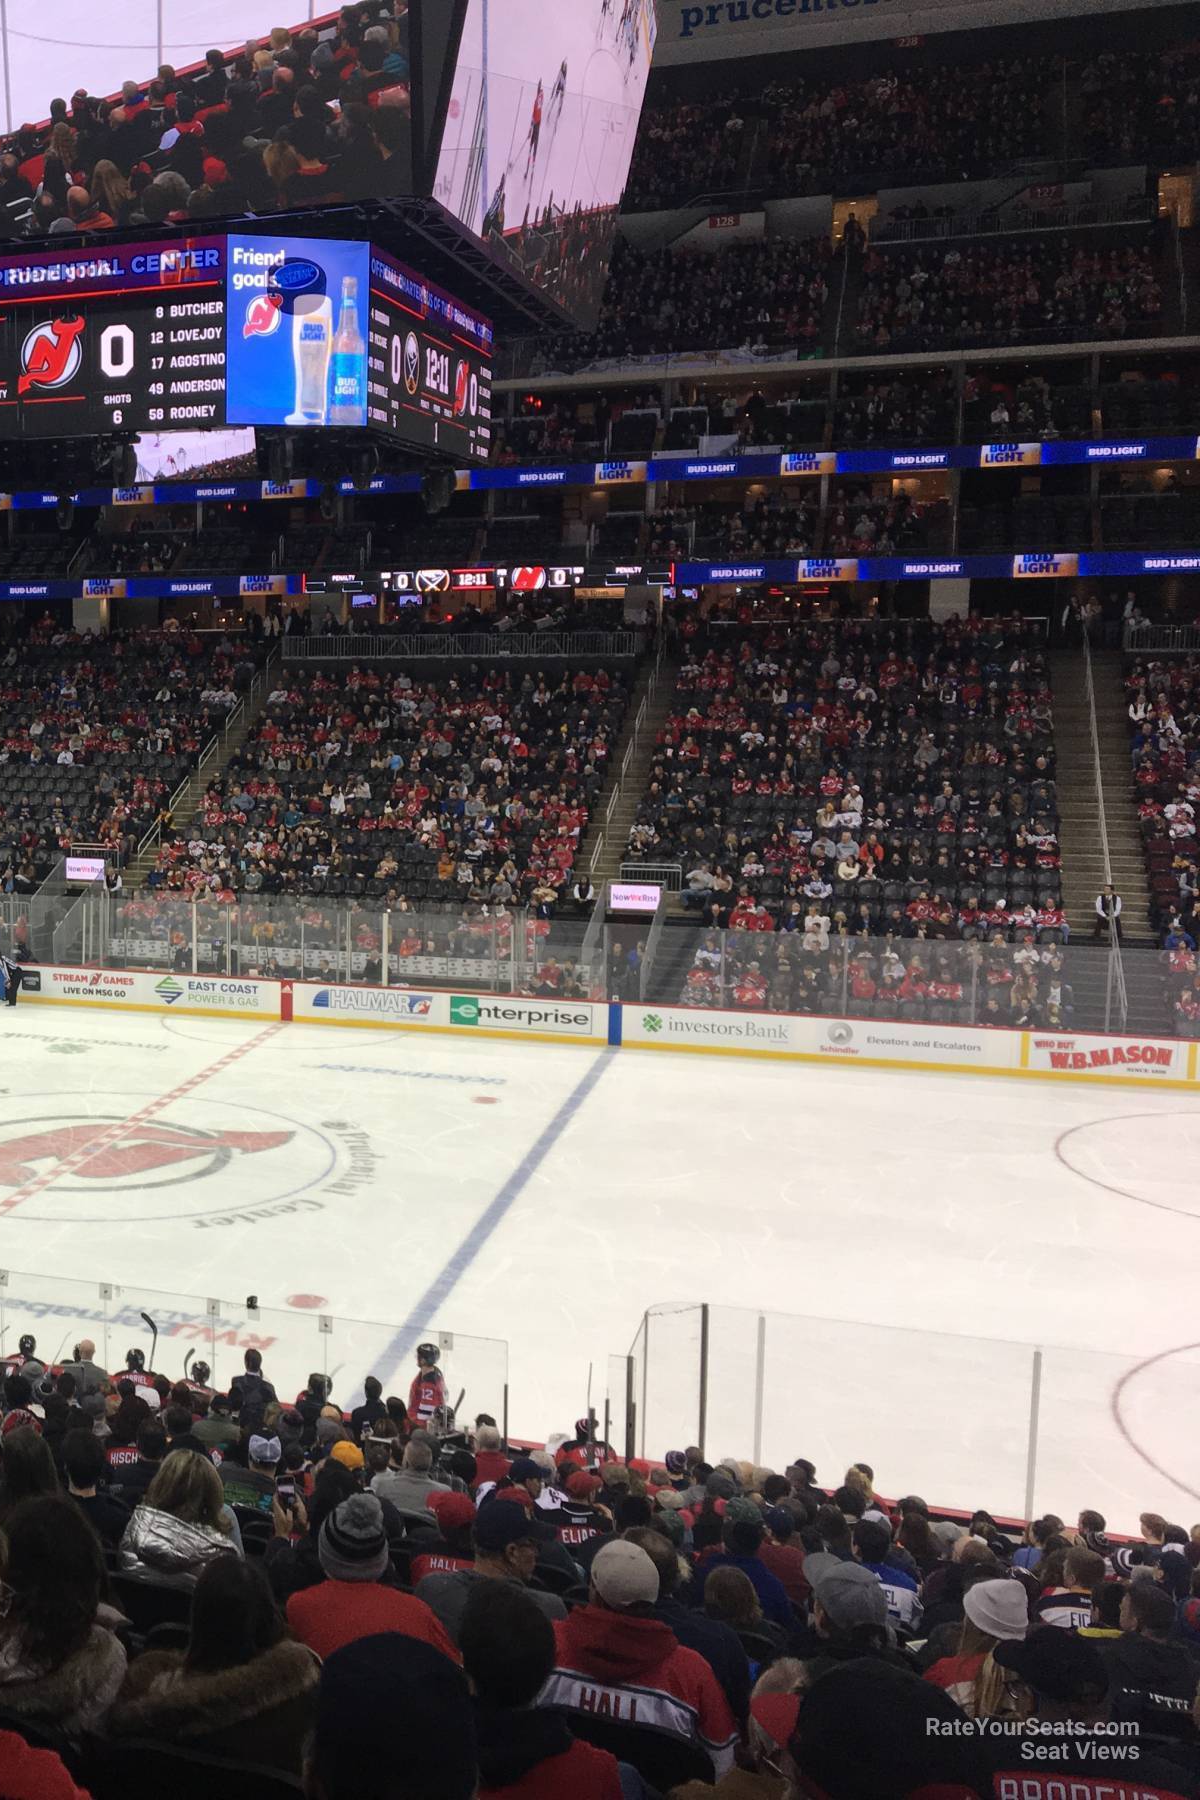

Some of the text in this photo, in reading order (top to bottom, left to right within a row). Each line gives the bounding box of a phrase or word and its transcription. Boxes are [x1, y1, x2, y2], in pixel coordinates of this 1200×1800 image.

[715, 216, 735, 228] 128
[131, 249, 219, 275] CENTER
[233, 247, 285, 266] Friend
[233, 272, 282, 290] goals.
[155, 301, 224, 318] 8 BUTCHER
[303, 323, 324, 332] BUD
[150, 327, 223, 344] 12 LOVEJOY
[300, 332, 326, 341] LIGHT
[101, 324, 134, 377] 0
[151, 352, 225, 369] 17 AGOSTINO
[391, 334, 401, 385] 0
[425, 347, 449, 395] 12:11
[148, 378, 226, 395] 49 ANDERSON
[337, 377, 357, 386] BUD
[334, 385, 360, 395] LIGHT
[469, 373, 478, 417] 0
[103, 394, 132, 405] SHOTS
[112, 410, 122, 424] 6
[149, 405, 216, 420] 58 ROONEY
[985, 451, 1024, 464] LIGHT
[1089, 446, 1144, 456] BUD LIGHT
[784, 460, 820, 472] LIGHT
[894, 455, 945, 465] BUD LIGHT
[599, 469, 632, 480] LIGHT
[688, 464, 735, 474] BUD LIGHT
[520, 473, 564, 482] BUD LIGHT
[213, 488, 235, 496] LIGHT
[615, 566, 642, 574] PENALTY
[906, 564, 961, 573] BUD LIGHT
[1018, 561, 1060, 574] LIGHT
[1145, 559, 1169, 569] BUD
[554, 570, 566, 585] 0
[712, 569, 763, 578] BUD LIGHT
[802, 565, 842, 579] LIGHT
[397, 574, 408, 589] 0
[459, 574, 487, 586] 12:11
[52, 973, 88, 983] STREAM
[103, 976, 134, 986] GAMES
[63, 986, 126, 998] LIVE ON MSG GO
[188, 981, 259, 995] EAST COAST
[188, 994, 259, 1007] POWER & GAS
[330, 989, 410, 1013] HALMAR
[456, 1004, 589, 1025] enterprise
[820, 1045, 859, 1054] Schindler
[866, 1036, 981, 1051] Elevators and Escalators
[1034, 1040, 1075, 1050] WHO BUT
[1050, 1045, 1173, 1069] W.B.MASON
[193, 1132, 386, 1229] Prudential Center
[421, 1389, 434, 1400] 12
[430, 1557, 458, 1572] HALL
